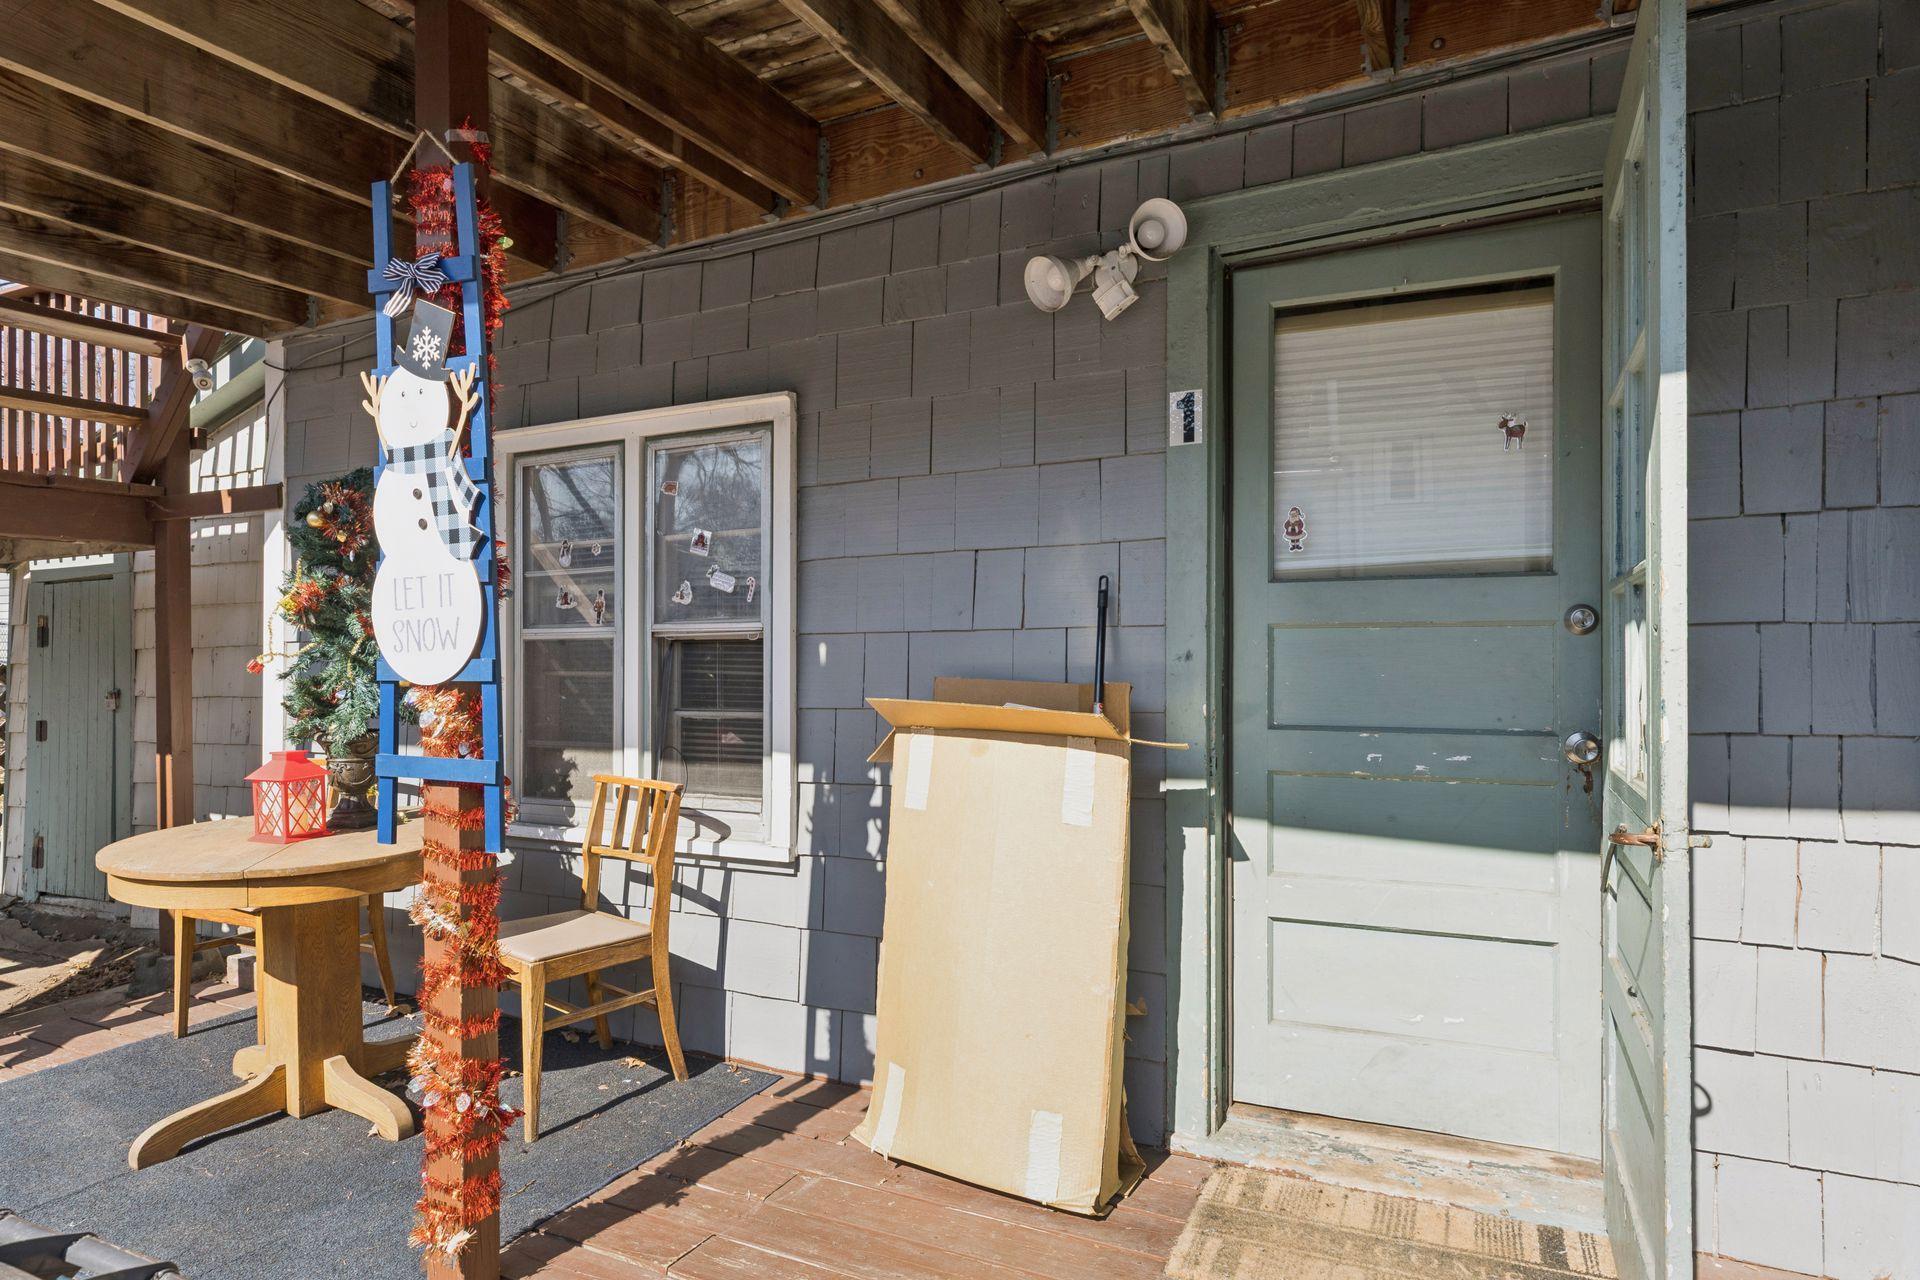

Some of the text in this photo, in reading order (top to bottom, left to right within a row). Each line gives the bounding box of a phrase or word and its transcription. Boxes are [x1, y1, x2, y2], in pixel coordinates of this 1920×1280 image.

[1176, 392, 1195, 443] 1
[393, 572, 455, 612] LET IT
[392, 616, 460, 653] SNOW
